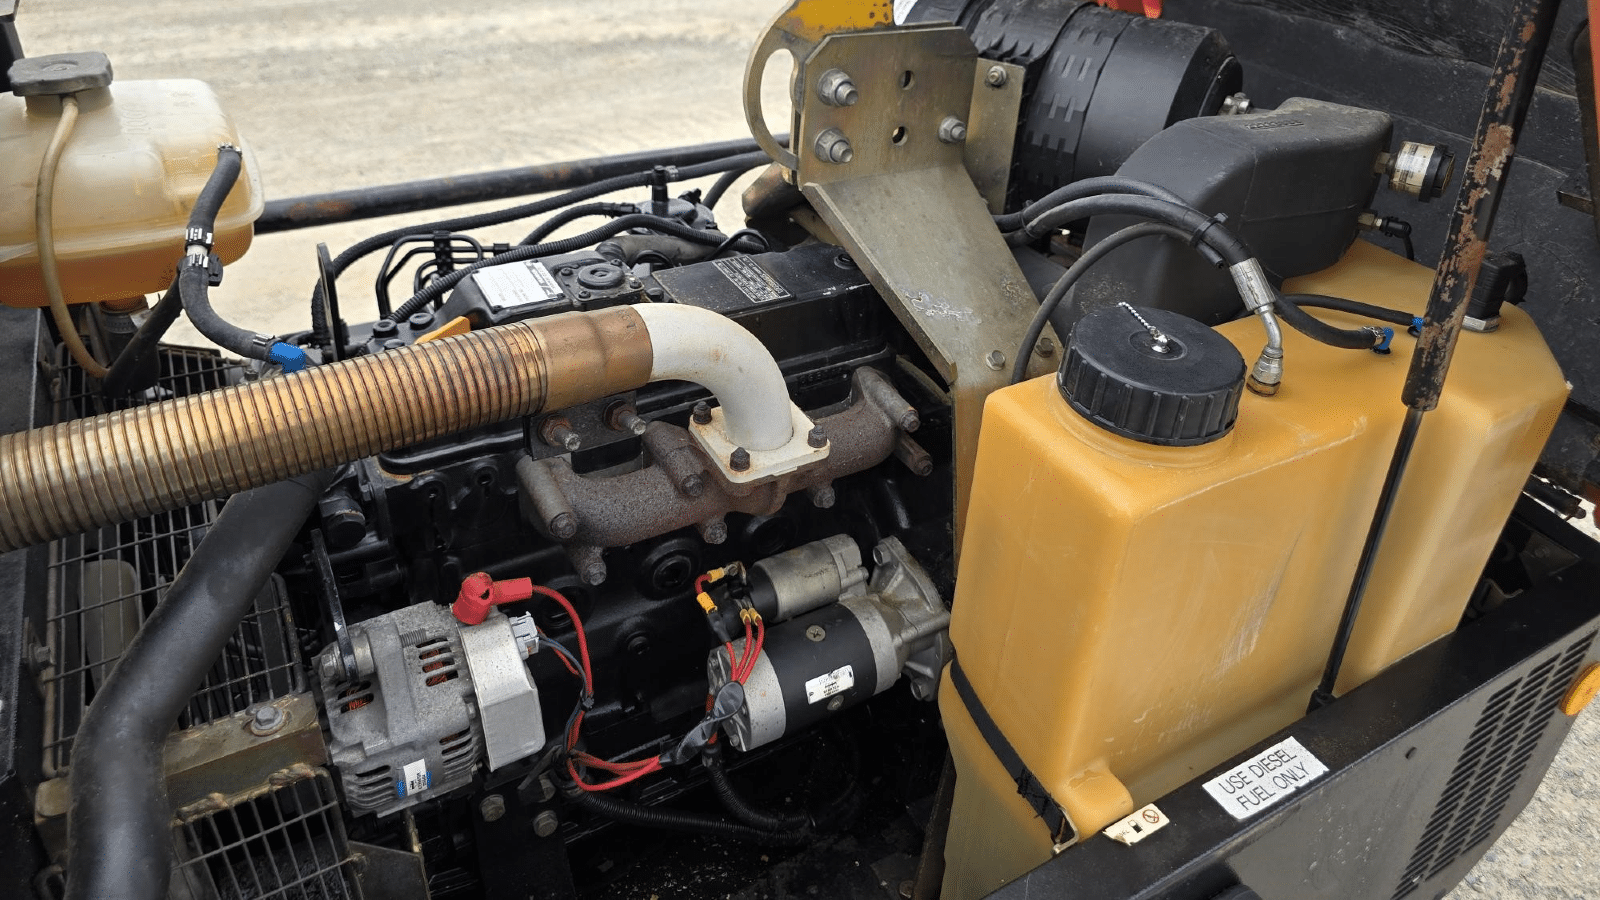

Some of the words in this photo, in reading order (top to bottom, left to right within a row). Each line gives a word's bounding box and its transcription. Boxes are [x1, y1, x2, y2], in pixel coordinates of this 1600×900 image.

[1218, 771, 1253, 795] USE
[1248, 749, 1298, 778] DIESEL
[1236, 785, 1277, 811] FUEL
[1272, 761, 1310, 790] ONLY
